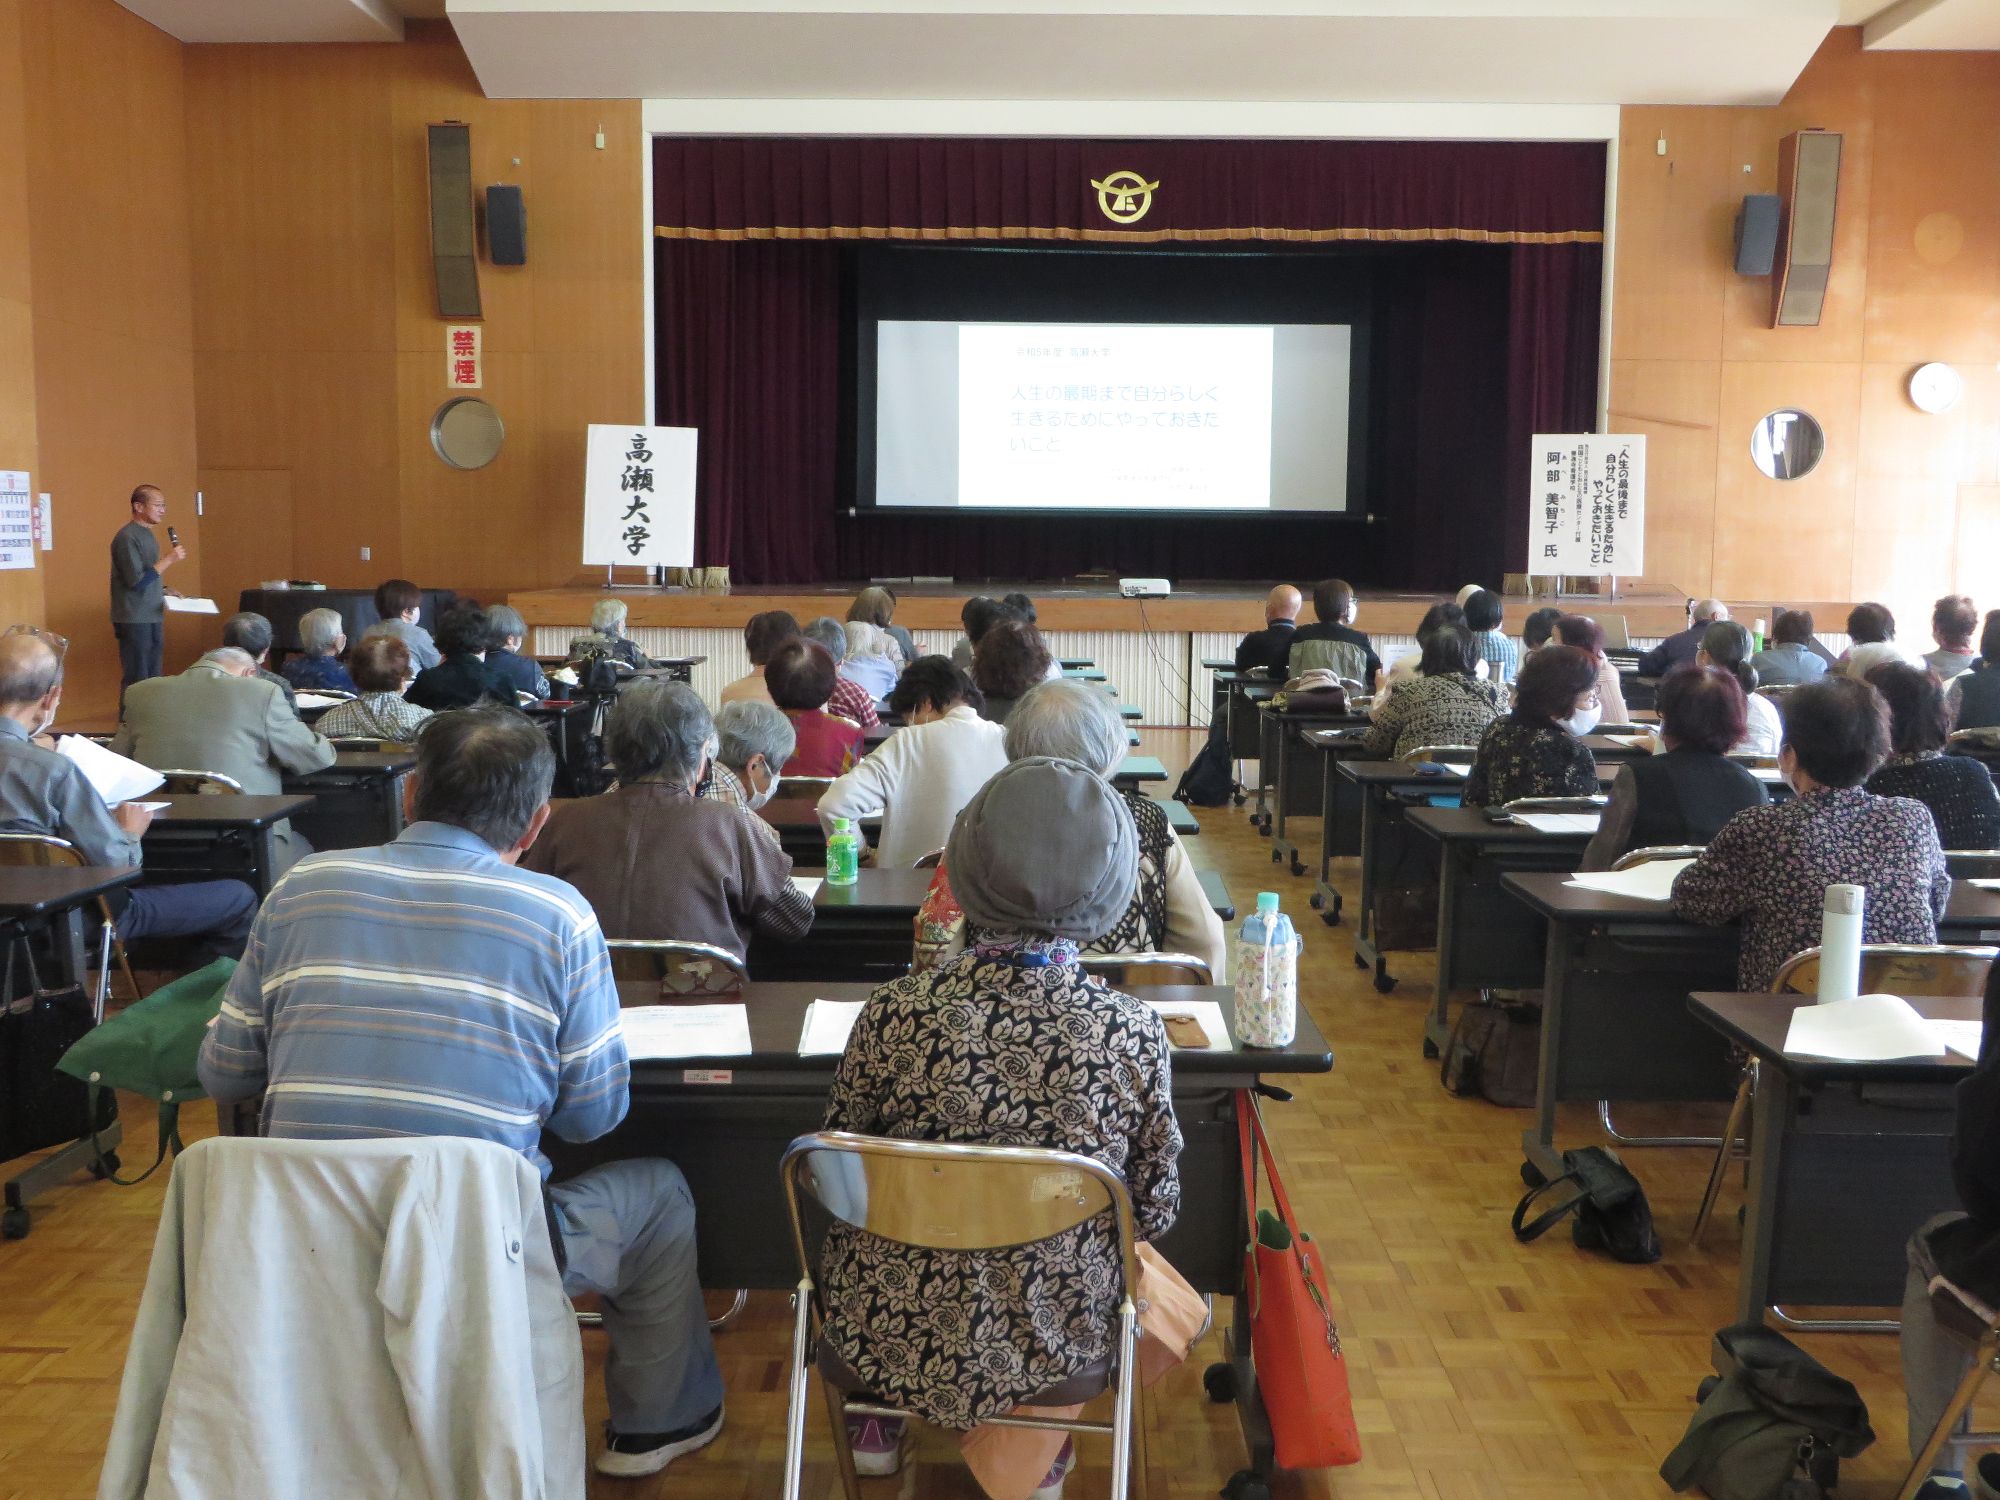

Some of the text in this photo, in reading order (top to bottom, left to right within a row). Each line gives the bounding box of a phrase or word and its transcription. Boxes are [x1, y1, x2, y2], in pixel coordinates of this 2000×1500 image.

[452, 330, 476, 384] 禁煙
[1010, 384, 1219, 402] 人生の最期まで自分らしく
[1010, 410, 1220, 428] 生きるためにやっておきた
[1010, 436, 1062, 452] いこと
[620, 433, 655, 556] 高瀬大学
[1544, 451, 1561, 558] 阿部 美智子 氏
[1603, 453, 1616, 564] 自分らしく生きるために
